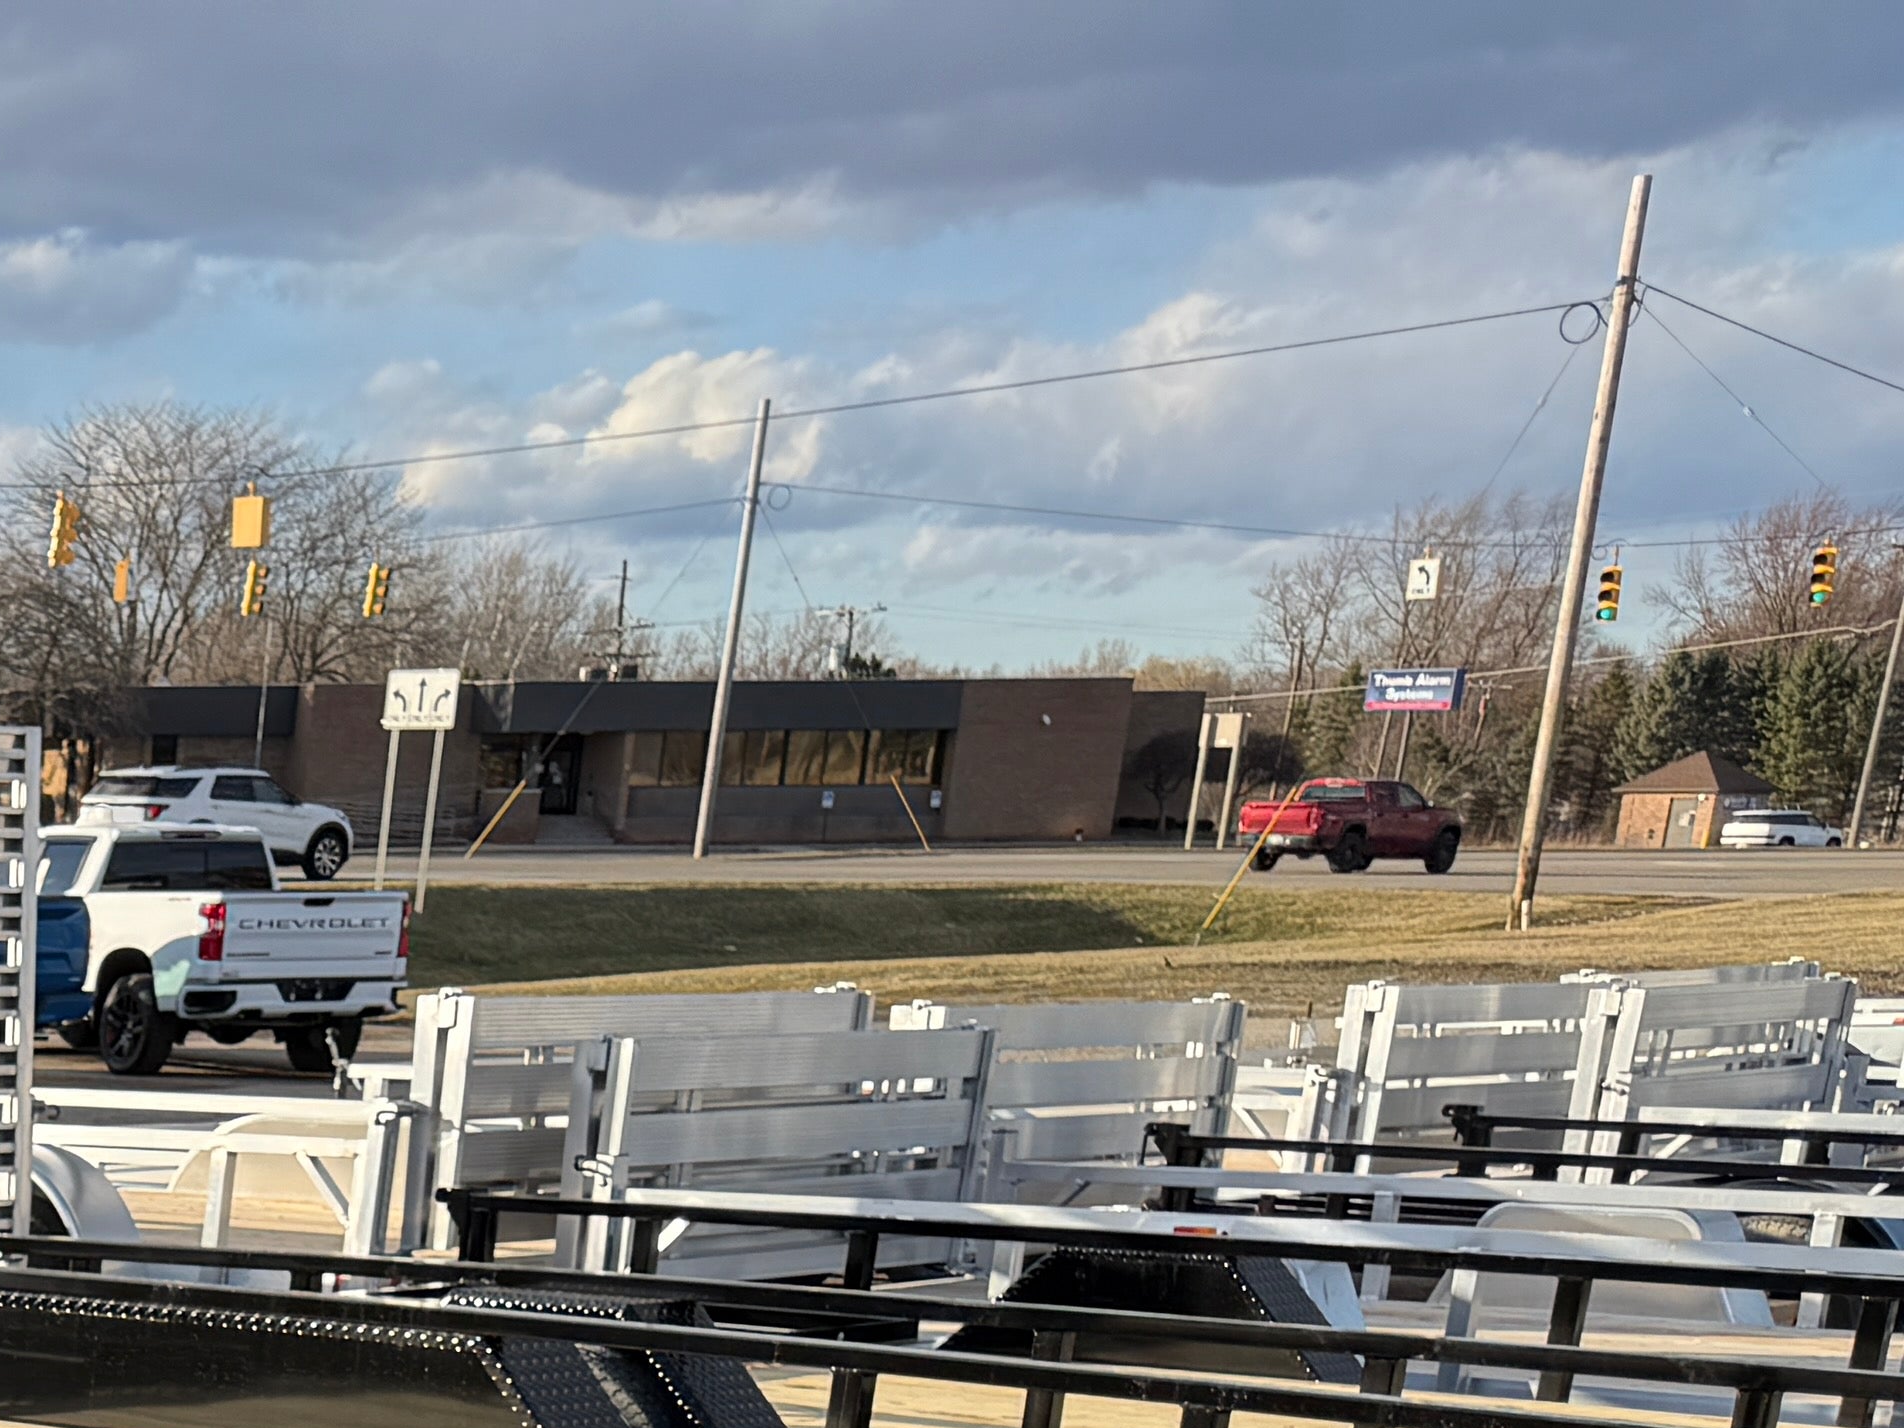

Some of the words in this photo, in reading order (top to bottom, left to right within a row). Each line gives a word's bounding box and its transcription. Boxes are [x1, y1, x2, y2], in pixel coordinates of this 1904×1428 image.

[1373, 673, 1414, 687] Thumb
[1415, 672, 1452, 687] Alarm
[238, 917, 391, 930] CHEVROLET
